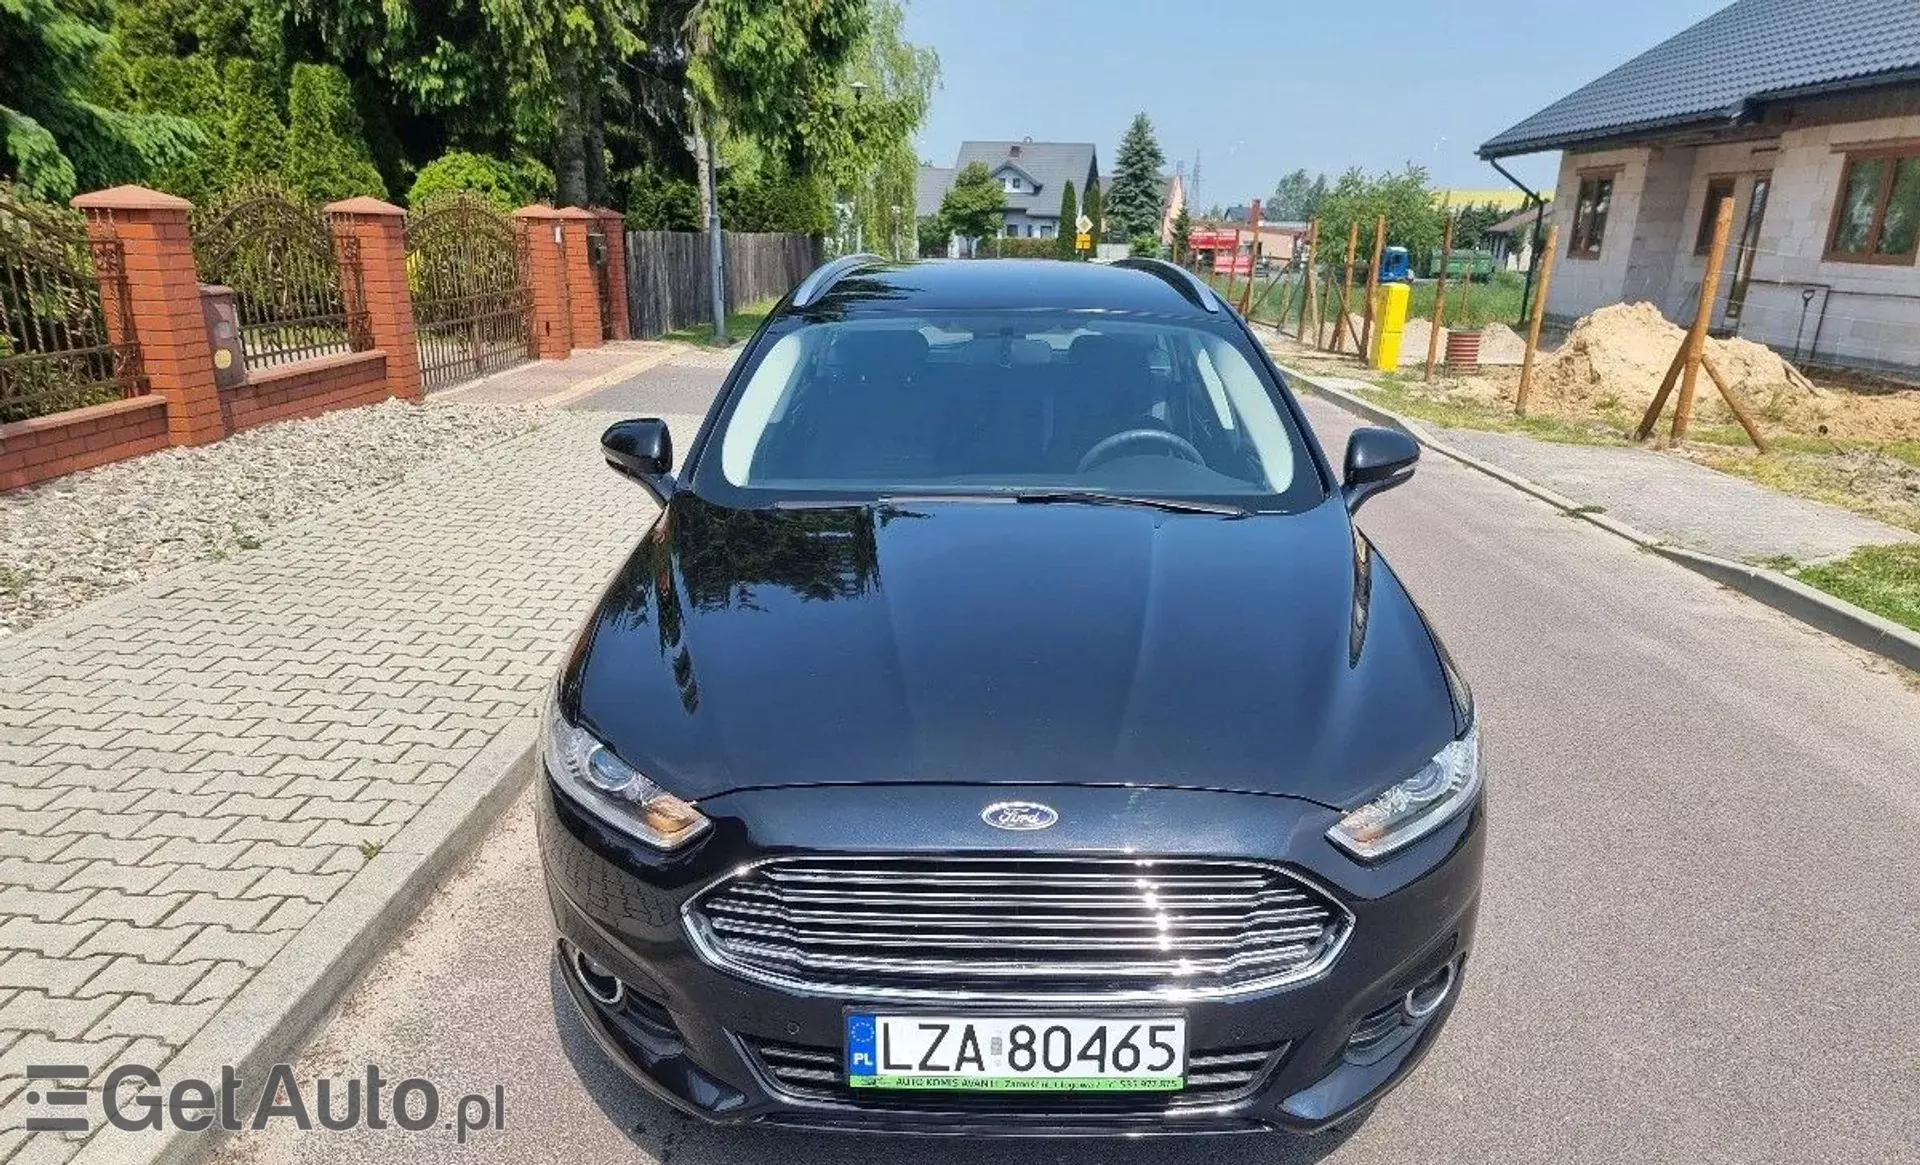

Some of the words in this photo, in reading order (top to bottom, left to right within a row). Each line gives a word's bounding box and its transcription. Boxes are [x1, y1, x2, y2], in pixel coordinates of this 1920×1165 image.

[999, 807, 1040, 824] Ford
[883, 1023, 985, 1071] LZA
[1008, 1023, 1176, 1073] 80465
[853, 1053, 873, 1066] PL
[895, 1078, 924, 1088] AUTO
[926, 1078, 959, 1088] KOMIS
